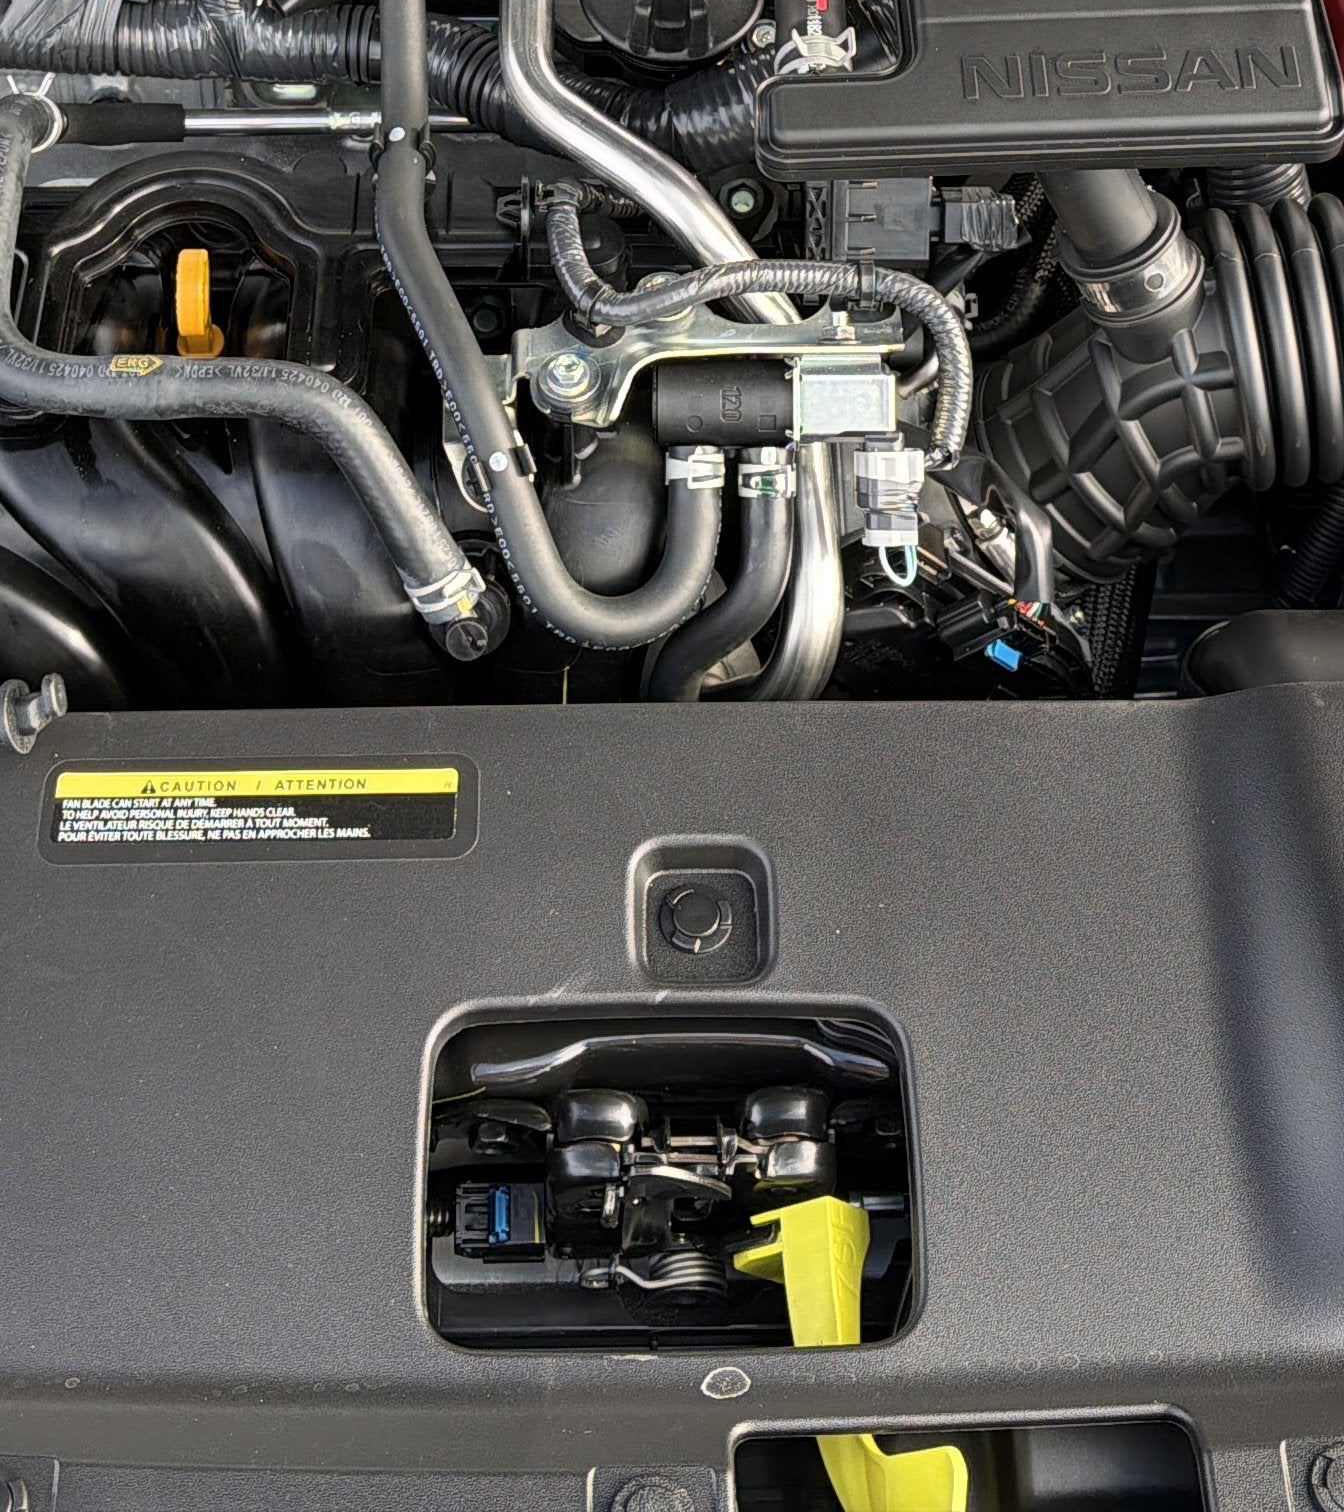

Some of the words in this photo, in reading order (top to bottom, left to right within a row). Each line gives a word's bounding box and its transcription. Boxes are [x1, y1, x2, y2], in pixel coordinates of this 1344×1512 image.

[961, 45, 1303, 100] NISSAN
[48, 363, 93, 379] 040425
[719, 386, 742, 424] 120
[160, 780, 237, 793] CAUTION
[274, 778, 367, 791] ATTENTION
[62, 799, 81, 808] FAN
[82, 799, 111, 808] BLADE
[112, 799, 132, 808] CAN
[133, 799, 160, 808] START
[161, 798, 173, 807] AT
[174, 798, 193, 807] ANY
[63, 810, 75, 819] TO
[76, 810, 99, 819] HELP
[100, 810, 129, 819] AVOID
[130, 809, 176, 819] PERSONAL
[210, 808, 233, 818] KEEP
[233, 808, 265, 817] HANDS
[60, 821, 71, 831] LE
[73, 821, 138, 830] VENTILATEUR
[139, 820, 174, 830] RISQUE
[176, 820, 189, 829] DE
[255, 819, 282, 828] TOUT
[59, 832, 86, 842] POUR
[123, 831, 154, 841] TOUTE
[207, 830, 221, 840] NE
[223, 830, 240, 839] PAS
[243, 830, 256, 839] EN
[258, 830, 316, 839] APPROCHER
[318, 829, 335, 838] LES
